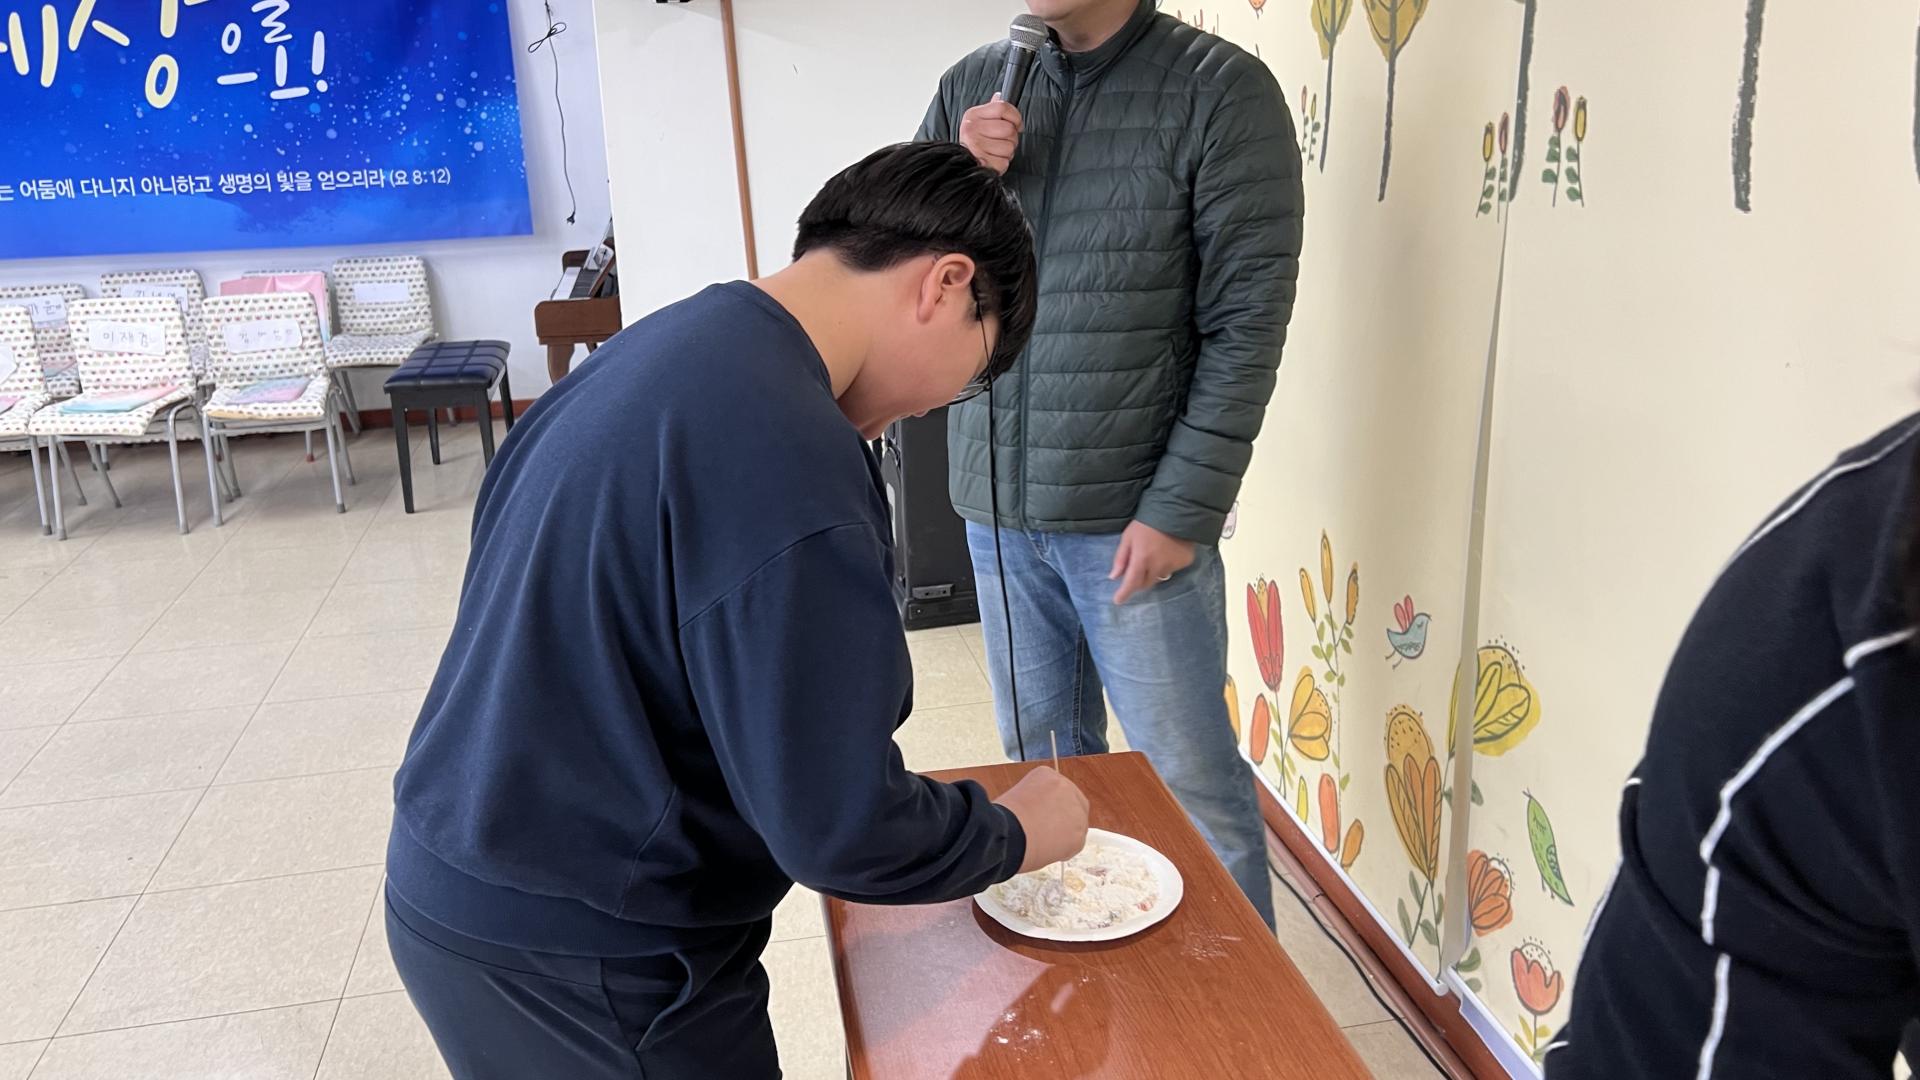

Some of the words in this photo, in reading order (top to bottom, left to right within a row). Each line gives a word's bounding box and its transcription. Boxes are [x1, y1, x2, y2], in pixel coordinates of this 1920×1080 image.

[19, 178, 76, 200] 어둠에
[80, 176, 136, 198] 다니지
[141, 174, 213, 196] 아니하고
[218, 172, 272, 194] 생명의
[277, 170, 313, 192] 빛을
[317, 168, 385, 191] 얻으리라
[389, 168, 410, 188] (요
[412, 167, 451, 186] 8:12)
